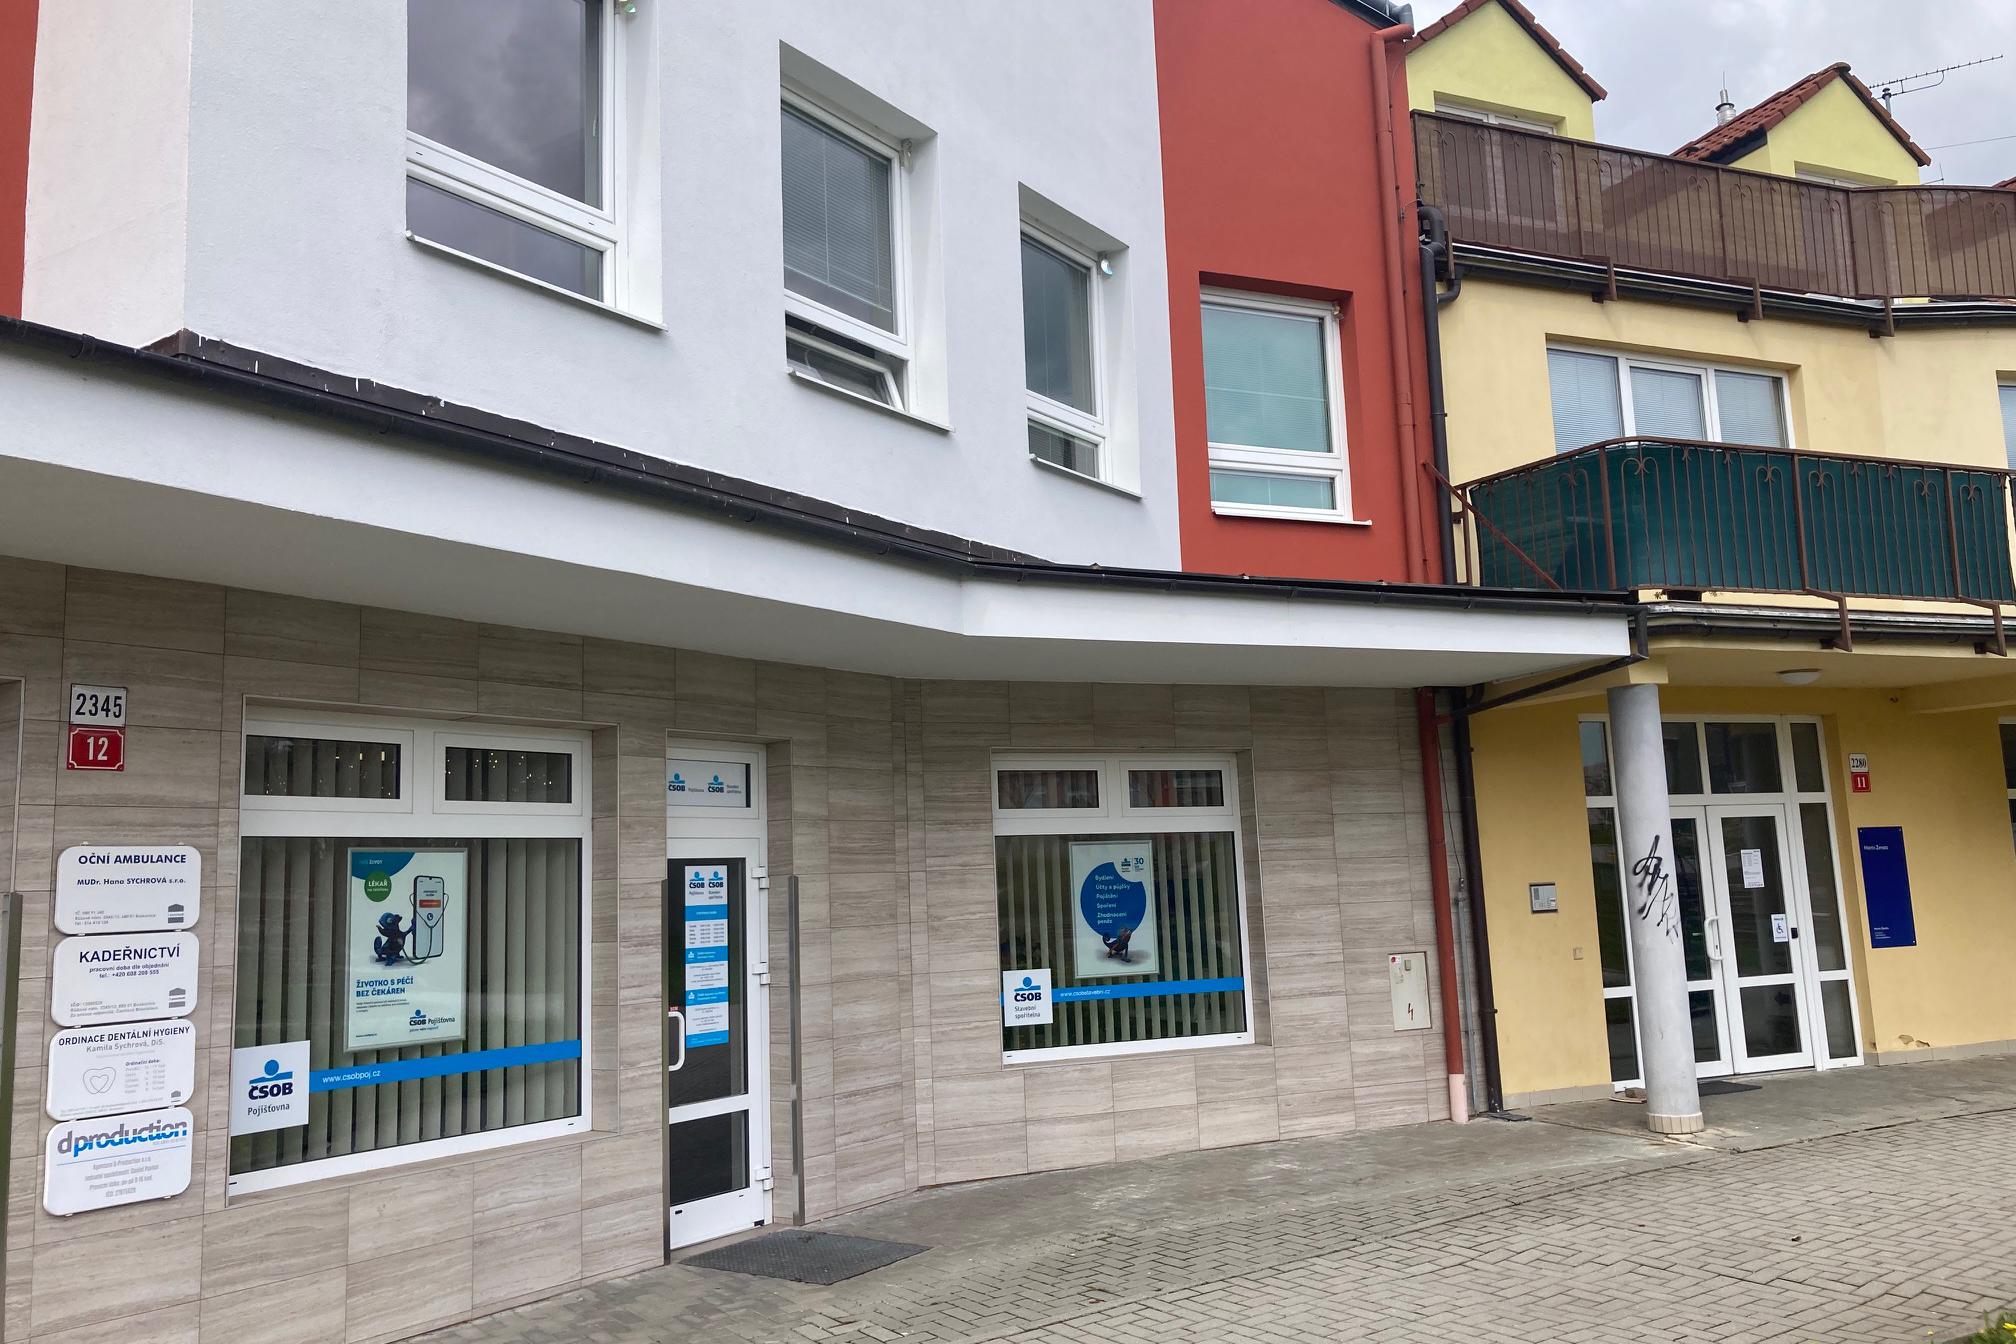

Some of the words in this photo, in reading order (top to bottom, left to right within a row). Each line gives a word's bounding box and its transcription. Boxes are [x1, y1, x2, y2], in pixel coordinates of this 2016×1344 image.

[75, 693, 122, 718] 2345
[87, 736, 109, 760] 12
[1851, 757, 1866, 768] 2280
[1857, 777, 1866, 788] 11
[78, 852, 110, 864] OČNÍ
[114, 854, 186, 864] AMBULANCE
[1134, 857, 1144, 865] 30
[77, 878, 101, 886] MUDr.
[126, 876, 167, 884] SYCHROVÁ
[368, 878, 388, 887] LÉKAŘ
[79, 943, 181, 963] KADEŘNICTVÍ
[356, 979, 389, 989] ŽIVOTKO
[390, 978, 395, 986] S
[396, 976, 414, 985] PÉČÍ
[356, 990, 370, 998] BEZ
[372, 987, 406, 996] ČEKÁREN
[1014, 992, 1042, 1002] ČSOB
[1014, 1012, 1041, 1020] spořitelna
[58, 1034, 105, 1046] ORDINACE
[107, 1028, 152, 1042] DENTÁLNÍ
[153, 1026, 190, 1037] HYGIENY
[86, 1043, 113, 1053] Kamila
[322, 1070, 381, 1084] www.csobpoj.cz
[248, 1082, 293, 1100] ČSOB
[247, 1104, 290, 1117] Pojišťovna
[57, 1119, 188, 1158] dproduction
